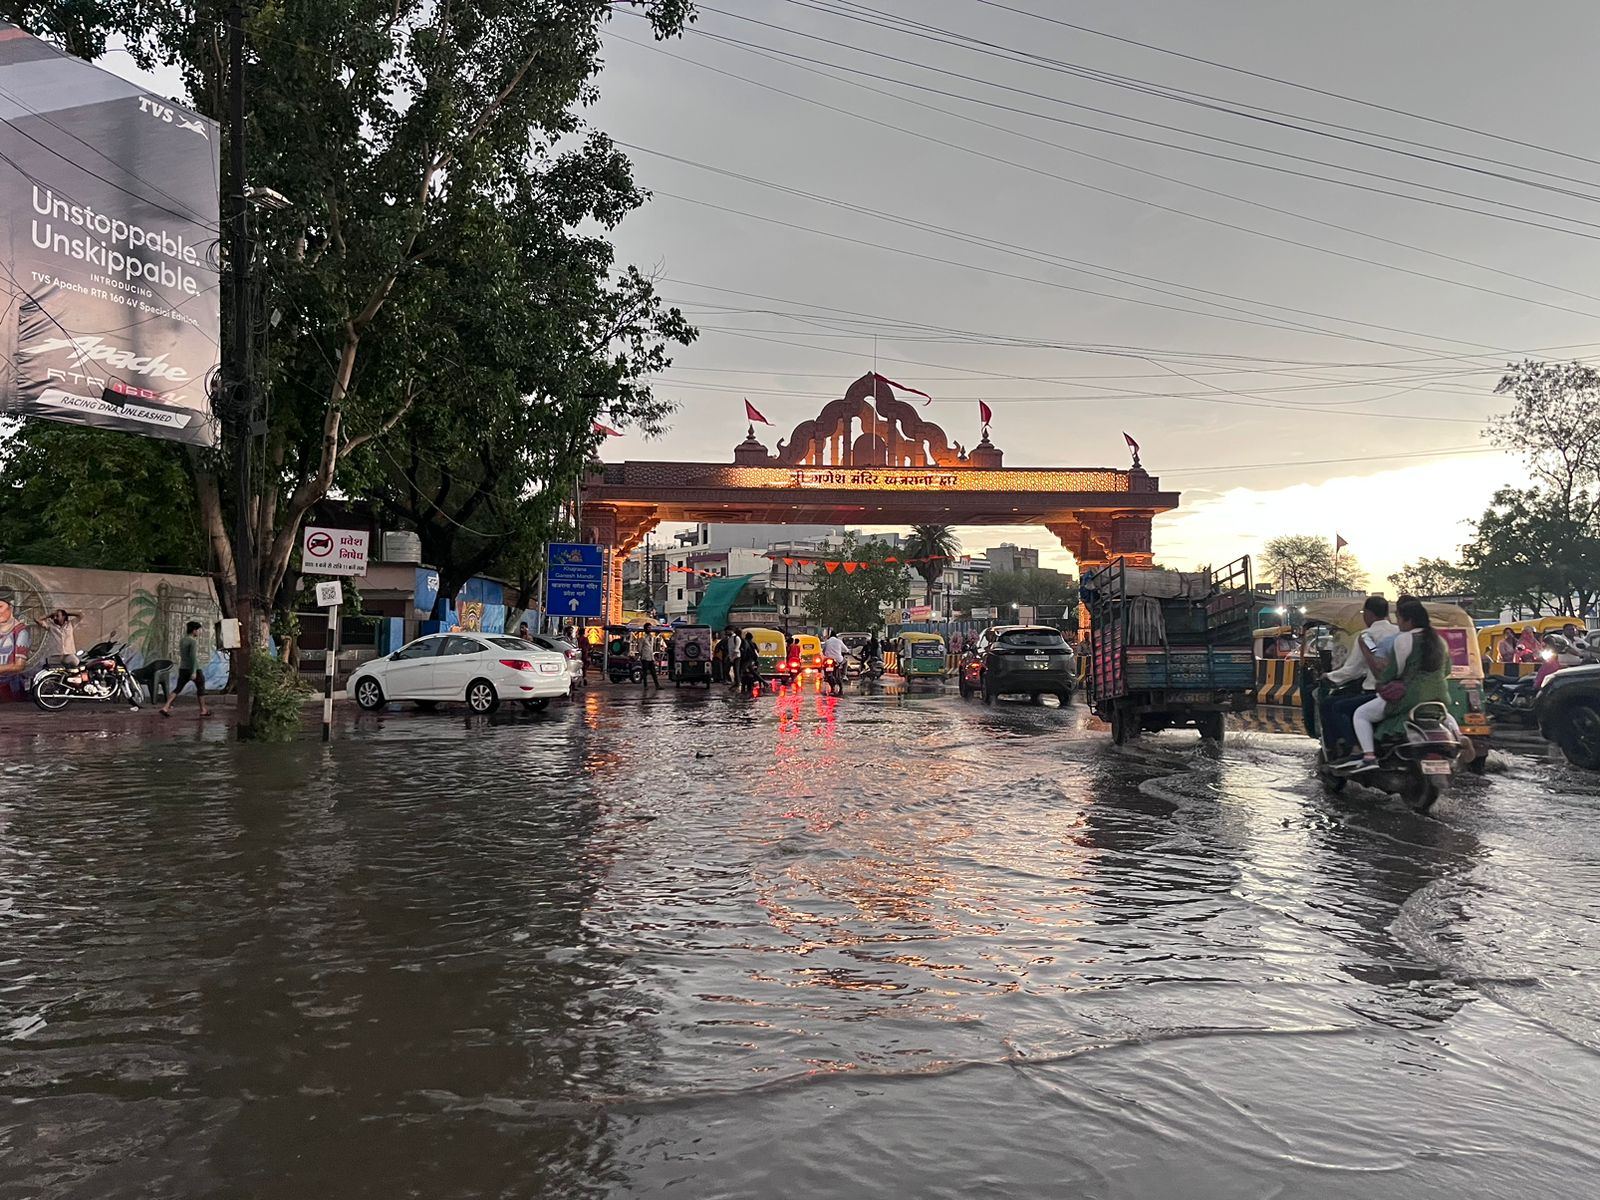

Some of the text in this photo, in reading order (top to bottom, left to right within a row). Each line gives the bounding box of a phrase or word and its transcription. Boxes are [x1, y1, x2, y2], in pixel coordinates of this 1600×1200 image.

[138, 96, 174, 123] TVS
[32, 185, 201, 267] Unstoppable.
[31, 219, 201, 297] Unskippable.
[31, 271, 51, 285] TVS
[53, 277, 89, 295] Apache
[90, 288, 108, 301] RTR
[109, 291, 125, 305] 160
[127, 297, 138, 308] 4V
[139, 302, 171, 318] Special
[90, 273, 153, 298] INTRODUCING
[19, 336, 192, 382] Apache
[47, 368, 105, 390] RTR
[61, 396, 173, 423] RACING DNA UNLEASHED
[850, 471, 878, 485] मंदिर
[339, 548, 363, 560] निषेध
[340, 535, 363, 546] प्रवेश
